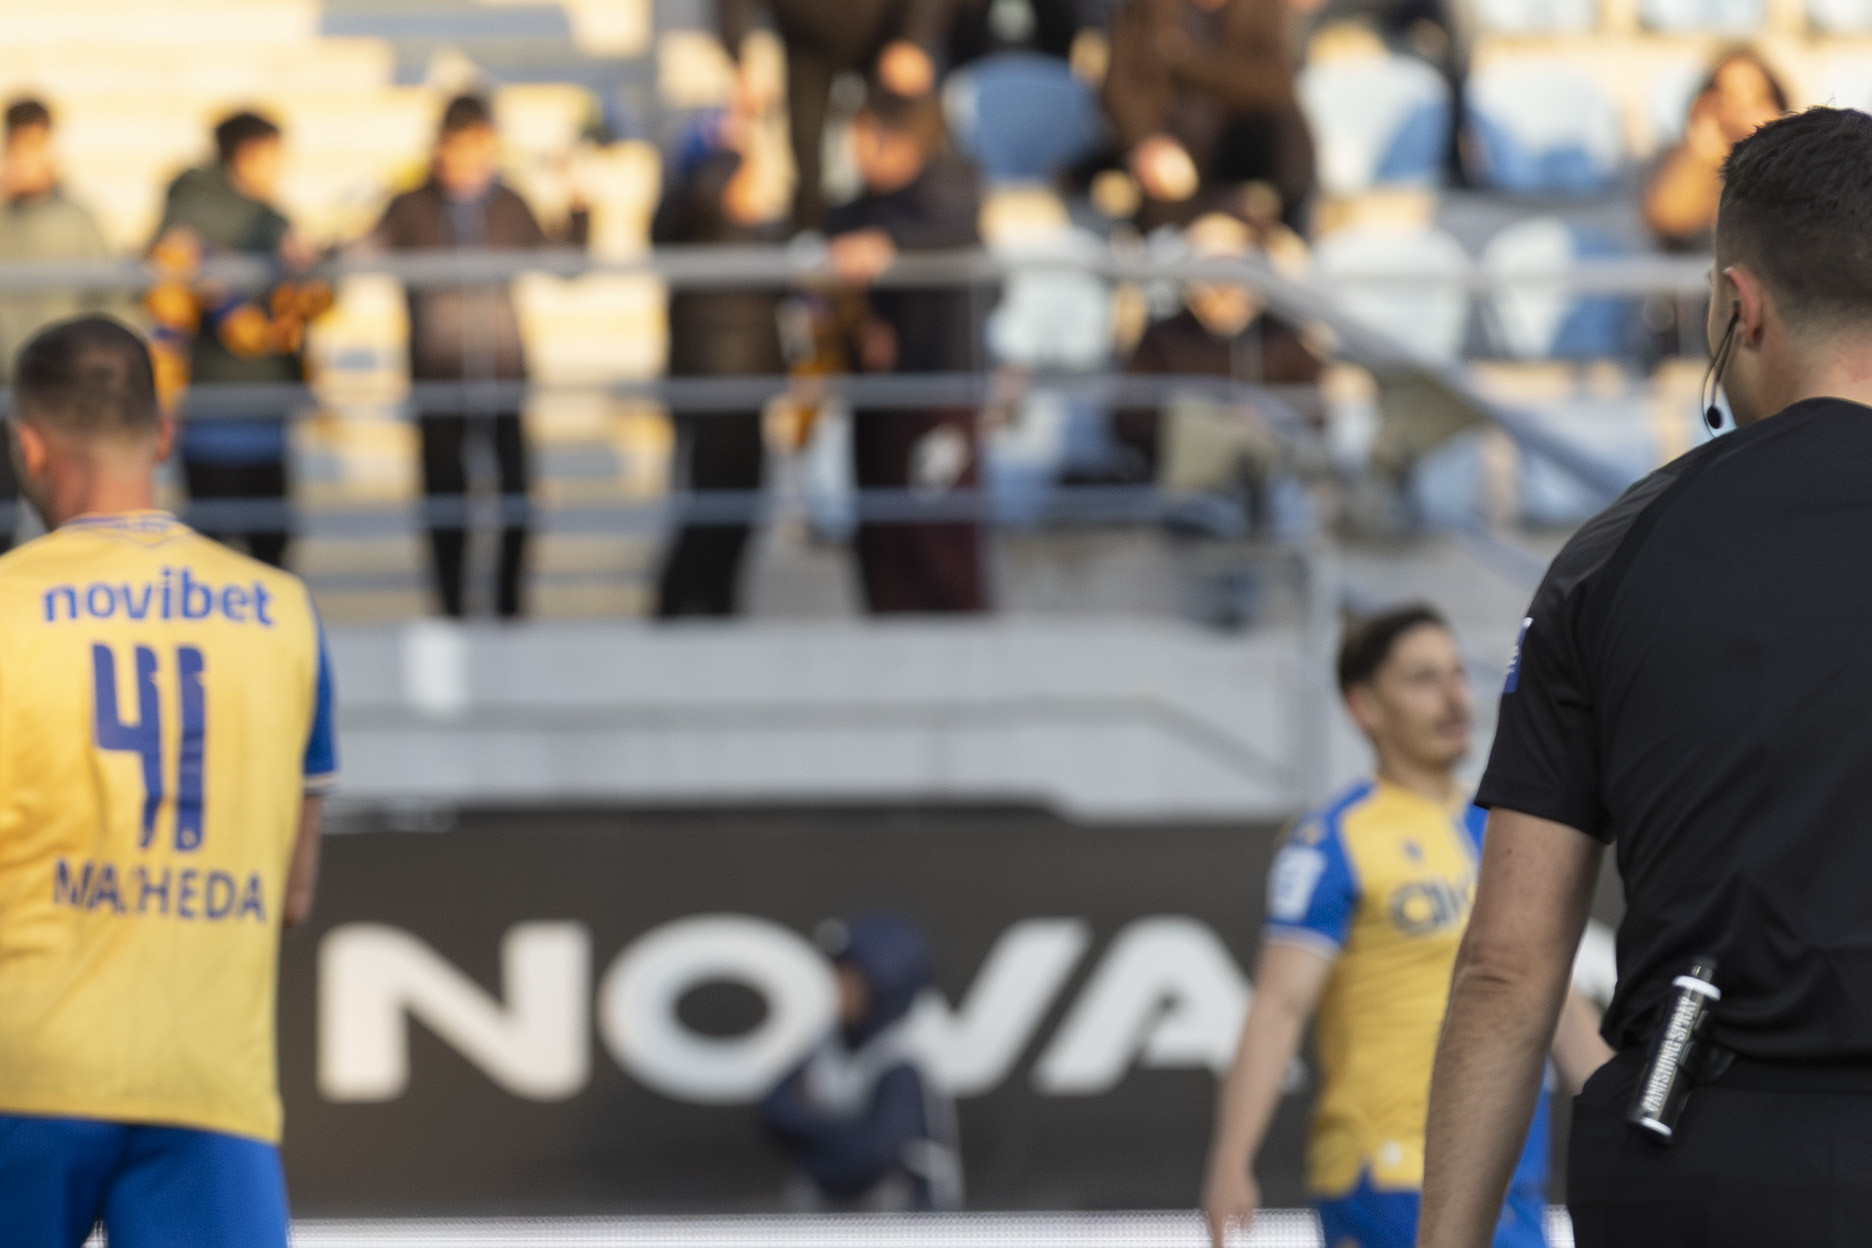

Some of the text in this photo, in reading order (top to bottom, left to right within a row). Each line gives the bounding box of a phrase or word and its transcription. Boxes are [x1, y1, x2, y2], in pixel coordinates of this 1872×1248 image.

[43, 566, 275, 627] novibet
[90, 642, 205, 852] 41
[52, 857, 267, 924] MAHEDA
[1641, 1039, 1682, 1113] VANISHING
